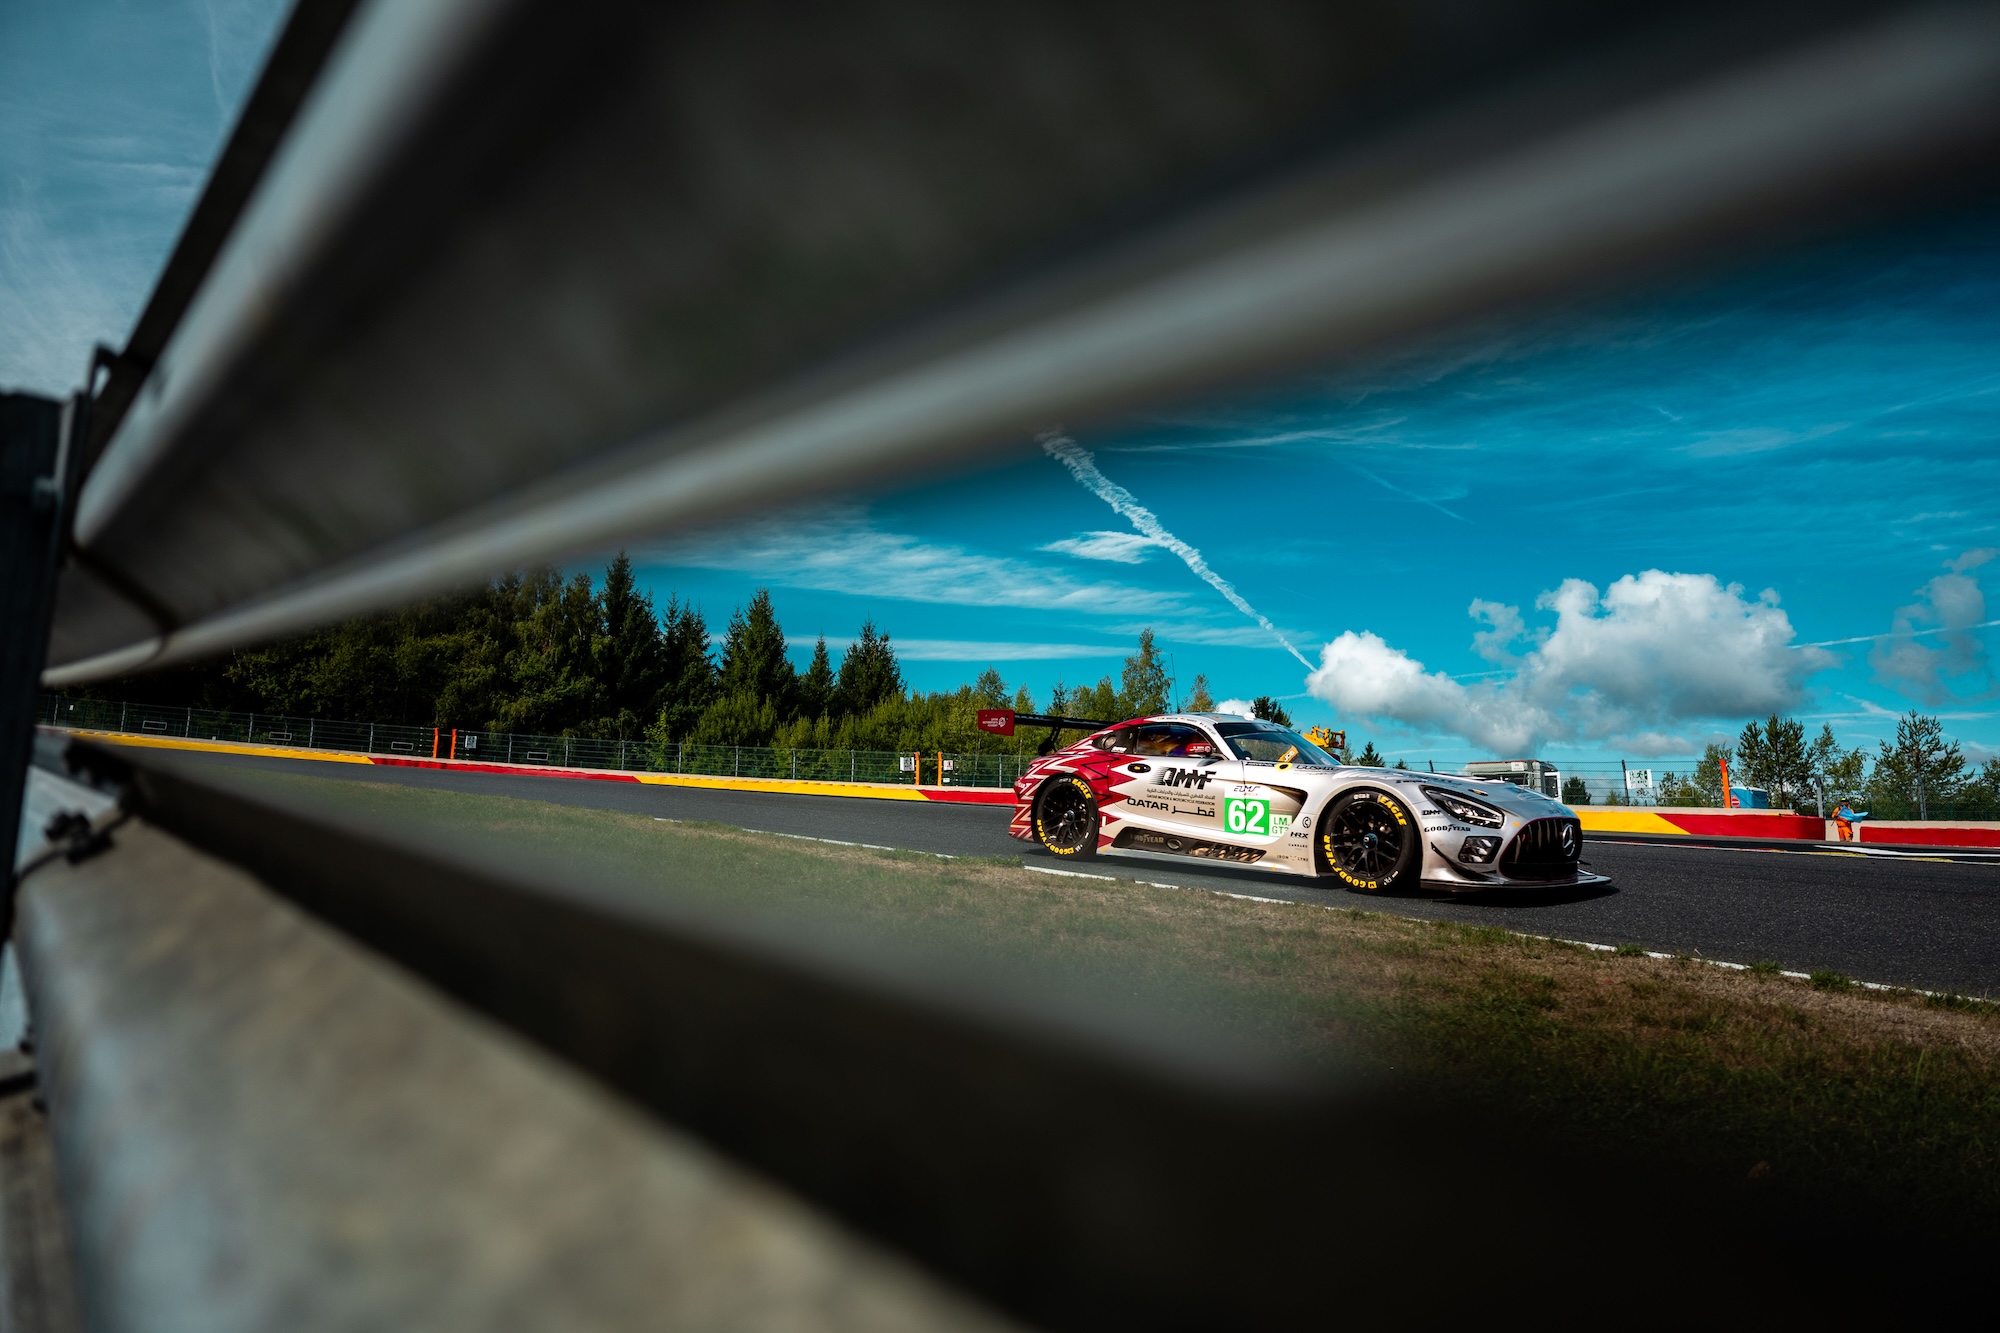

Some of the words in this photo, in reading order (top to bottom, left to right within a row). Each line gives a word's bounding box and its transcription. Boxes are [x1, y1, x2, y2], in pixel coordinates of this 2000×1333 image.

[1072, 778, 1092, 799] EAGLE
[1152, 767, 1217, 790] QMMF
[1127, 797, 1168, 811] QATAR
[1171, 806, 1215, 817] قطر
[1379, 795, 1407, 825] EAGLE
[1228, 800, 1265, 833] 62
[1424, 824, 1471, 832] GOODYEAR
[1037, 819, 1068, 855] GOODYEAR
[1323, 834, 1366, 888] GOODYEAR
